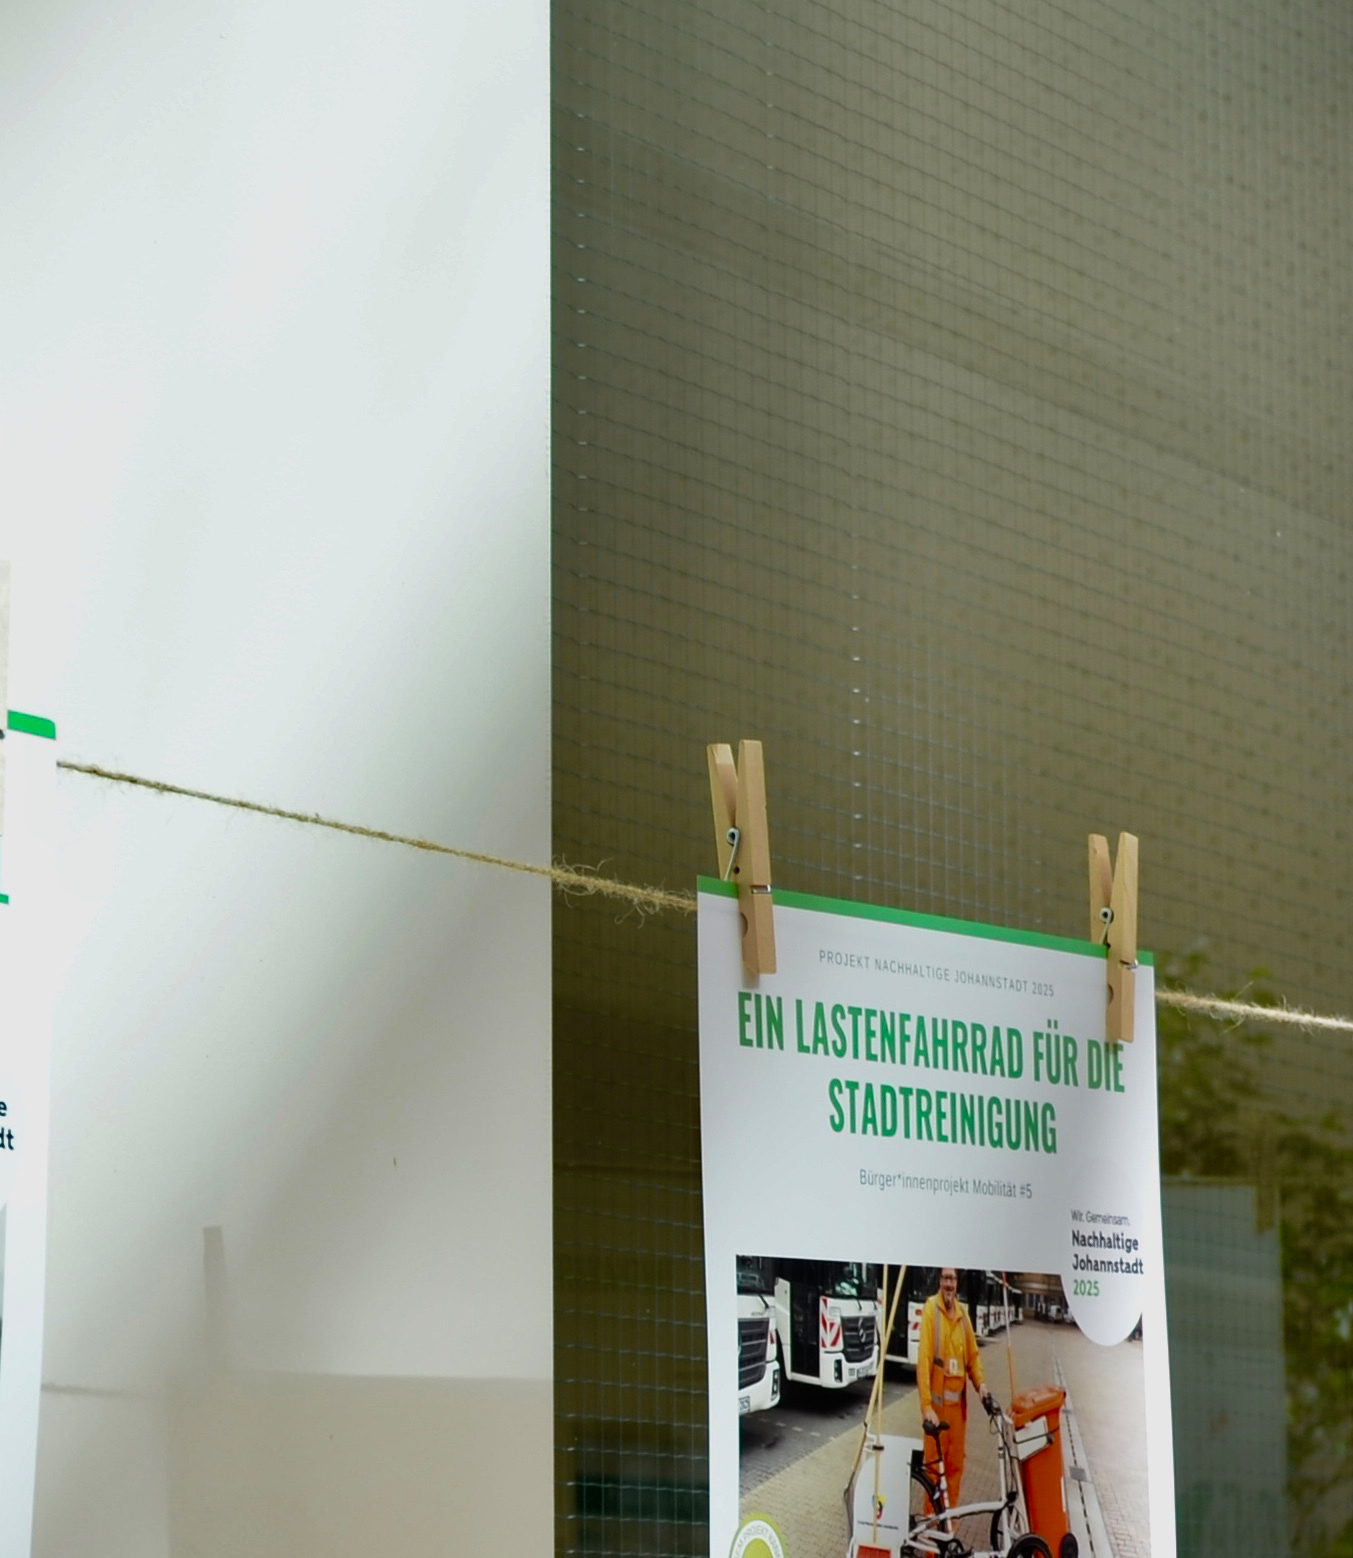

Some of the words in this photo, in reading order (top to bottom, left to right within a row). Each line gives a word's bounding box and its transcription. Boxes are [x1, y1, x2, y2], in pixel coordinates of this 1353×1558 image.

[819, 950, 870, 969] PROJEKT
[875, 957, 950, 982] NACHHALTIGE
[954, 968, 1027, 993] JOHANNSTADT
[1032, 981, 1054, 997] 2025
[738, 991, 783, 1050] EIN
[796, 999, 1023, 1079] LASTENFAHRRAD
[1033, 1019, 1079, 1088] FÜR
[1087, 1041, 1124, 1093] DIE
[829, 1078, 1057, 1154] STADTREINIGUNG
[972, 1175, 1016, 1198] Mobilität
[1020, 1184, 1033, 1199] #5
[1072, 1229, 1138, 1252] Nachhaltige
[1072, 1254, 1143, 1274] Johannstadt
[1073, 1279, 1099, 1296] 2025
